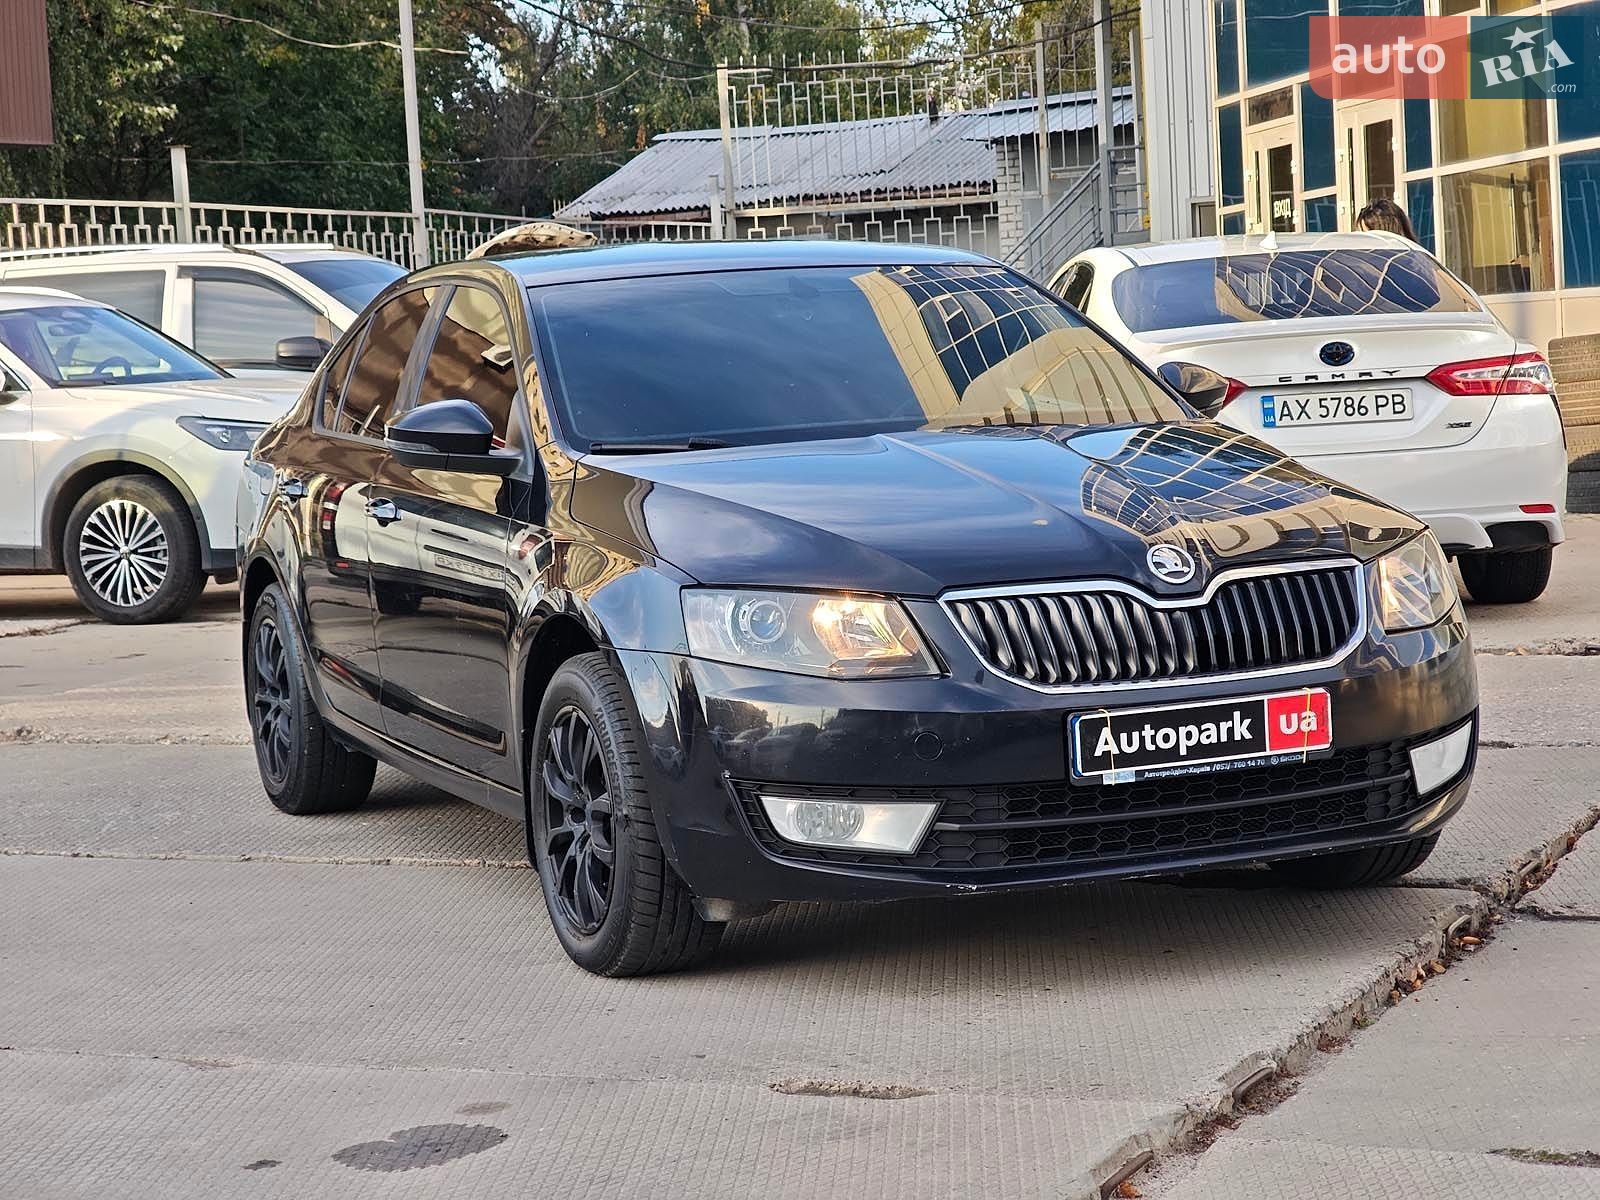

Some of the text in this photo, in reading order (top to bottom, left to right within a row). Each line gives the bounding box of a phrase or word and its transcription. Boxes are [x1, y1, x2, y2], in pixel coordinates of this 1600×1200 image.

[1278, 369, 1401, 383] CAMRY
[1278, 393, 1407, 422] AX 5786 PB
[1264, 415, 1275, 424] UA
[1093, 709, 1318, 757] Autopark ua
